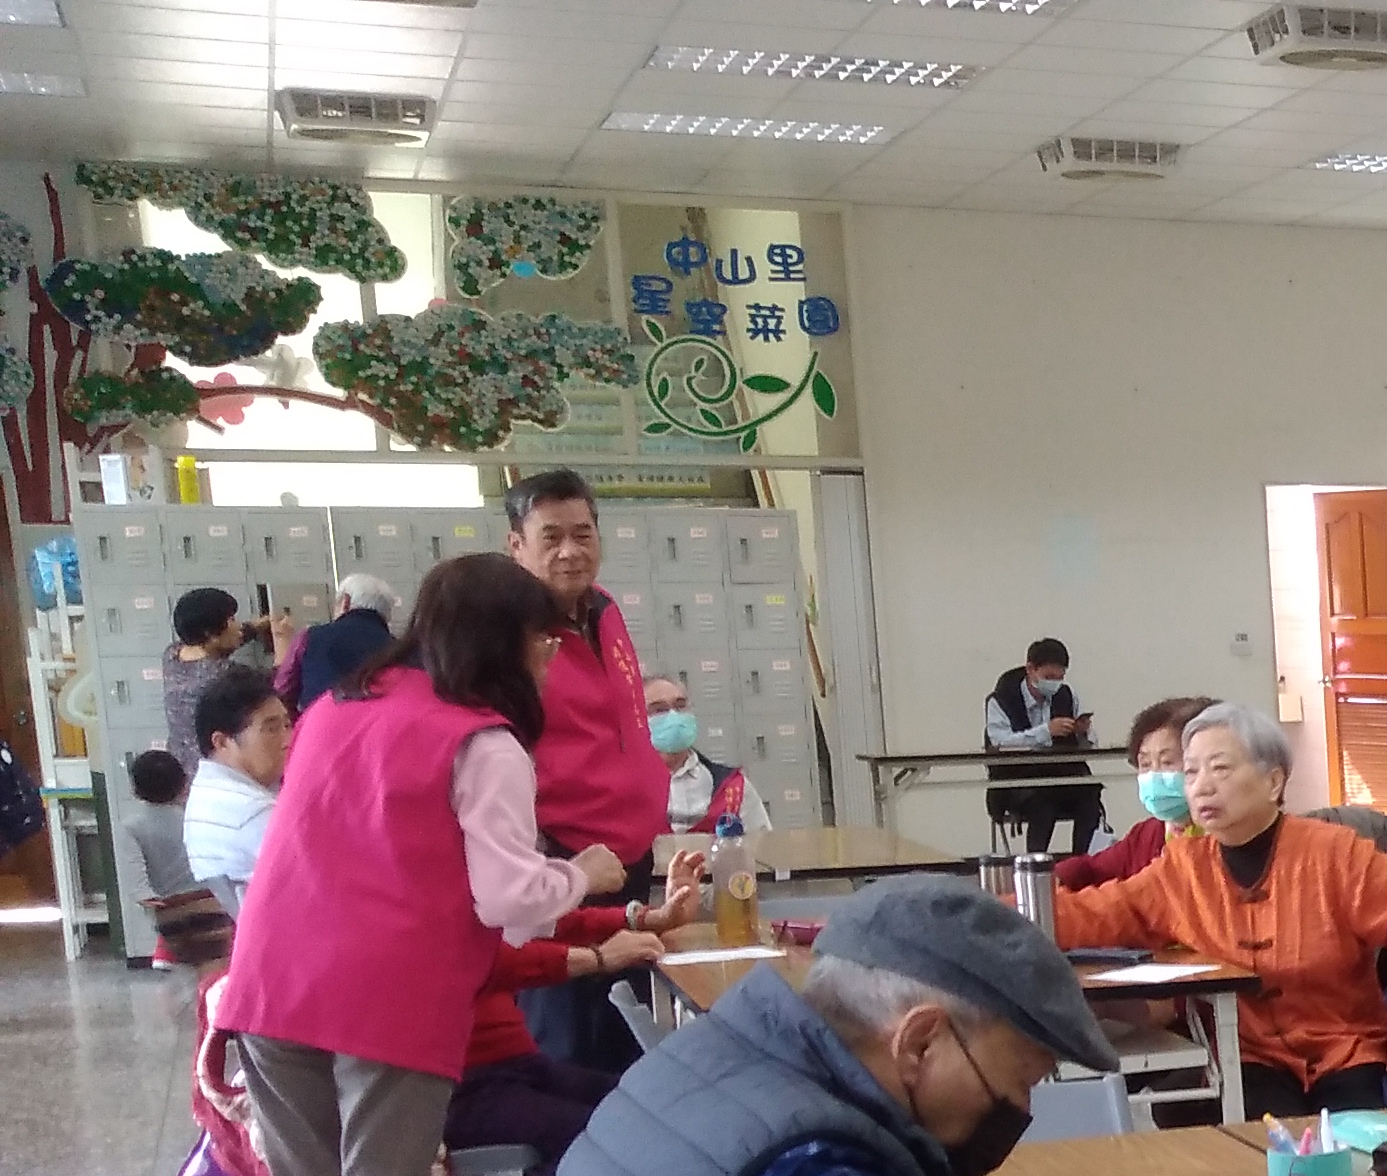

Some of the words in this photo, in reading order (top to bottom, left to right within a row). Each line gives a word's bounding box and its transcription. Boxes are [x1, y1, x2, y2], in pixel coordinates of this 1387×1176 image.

[665, 235, 807, 286] 中山里
[631, 274, 840, 343] 星空菜園
